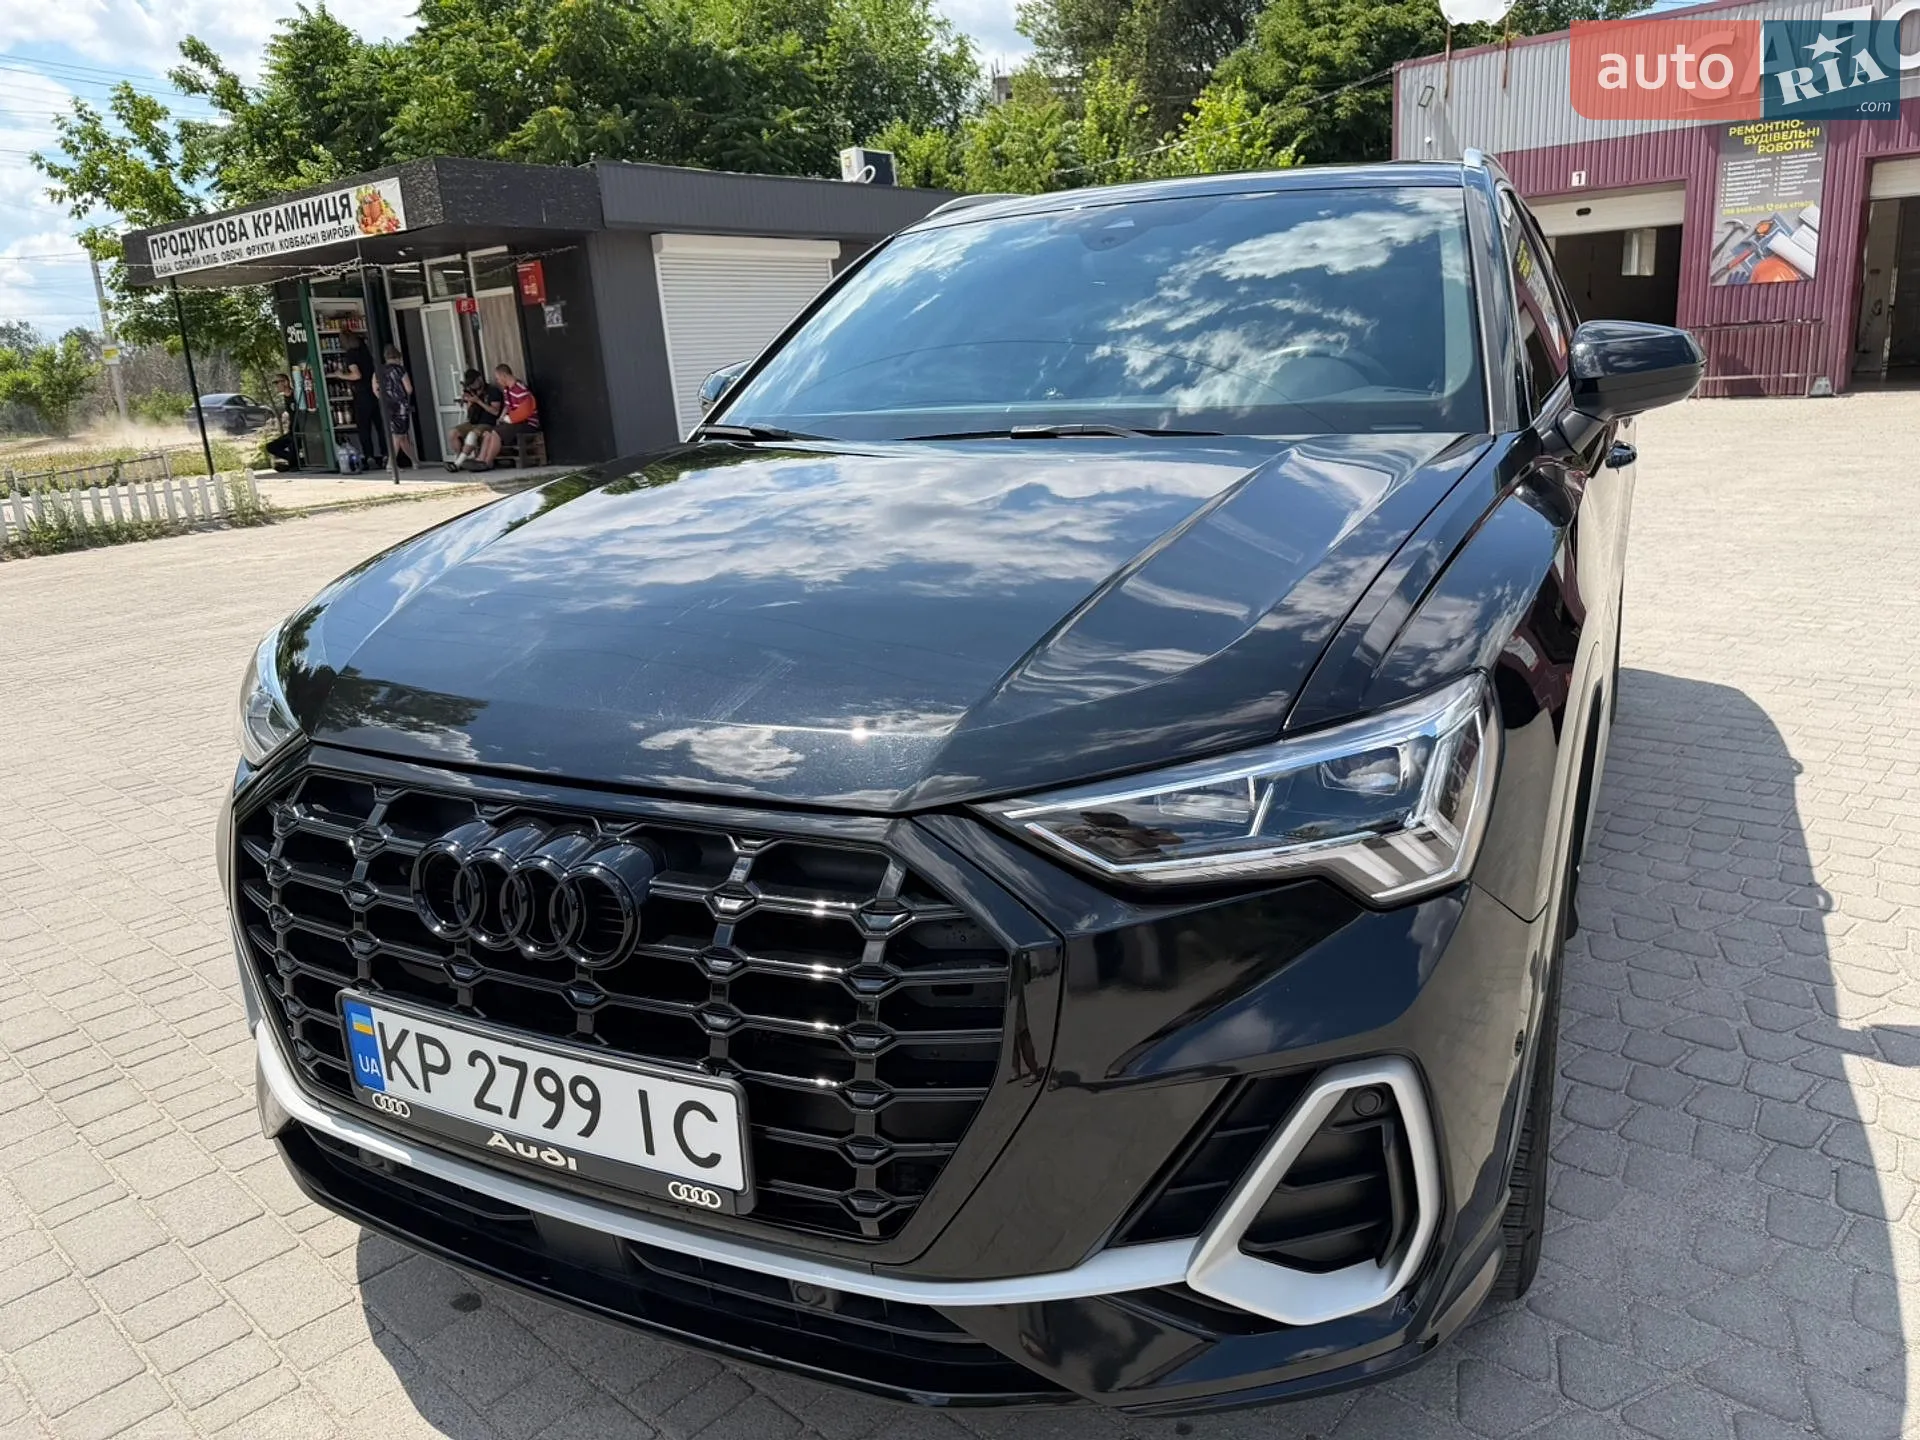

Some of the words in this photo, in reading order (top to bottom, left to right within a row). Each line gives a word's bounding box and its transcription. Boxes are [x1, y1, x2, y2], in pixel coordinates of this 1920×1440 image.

[1728, 119, 1805, 137] РЕМОНТНО-
[1744, 127, 1820, 145] БУДІВЕЛЬНІ
[1757, 139, 1814, 154] РОБОТИ:
[151, 218, 249, 260] ПРОДУКТОВА
[251, 193, 353, 239] КРАМНИЦЯ
[221, 248, 243, 262] ОВОЧІ
[246, 241, 276, 257] ФРУКТИ
[279, 233, 320, 251] КОВБАСНІ
[321, 226, 357, 244] ВИРОБИ
[358, 1053, 381, 1078] UA
[377, 1021, 451, 1094] KP
[467, 1049, 600, 1138] 2799
[638, 1088, 722, 1169] IC
[486, 1131, 578, 1172] Audi
